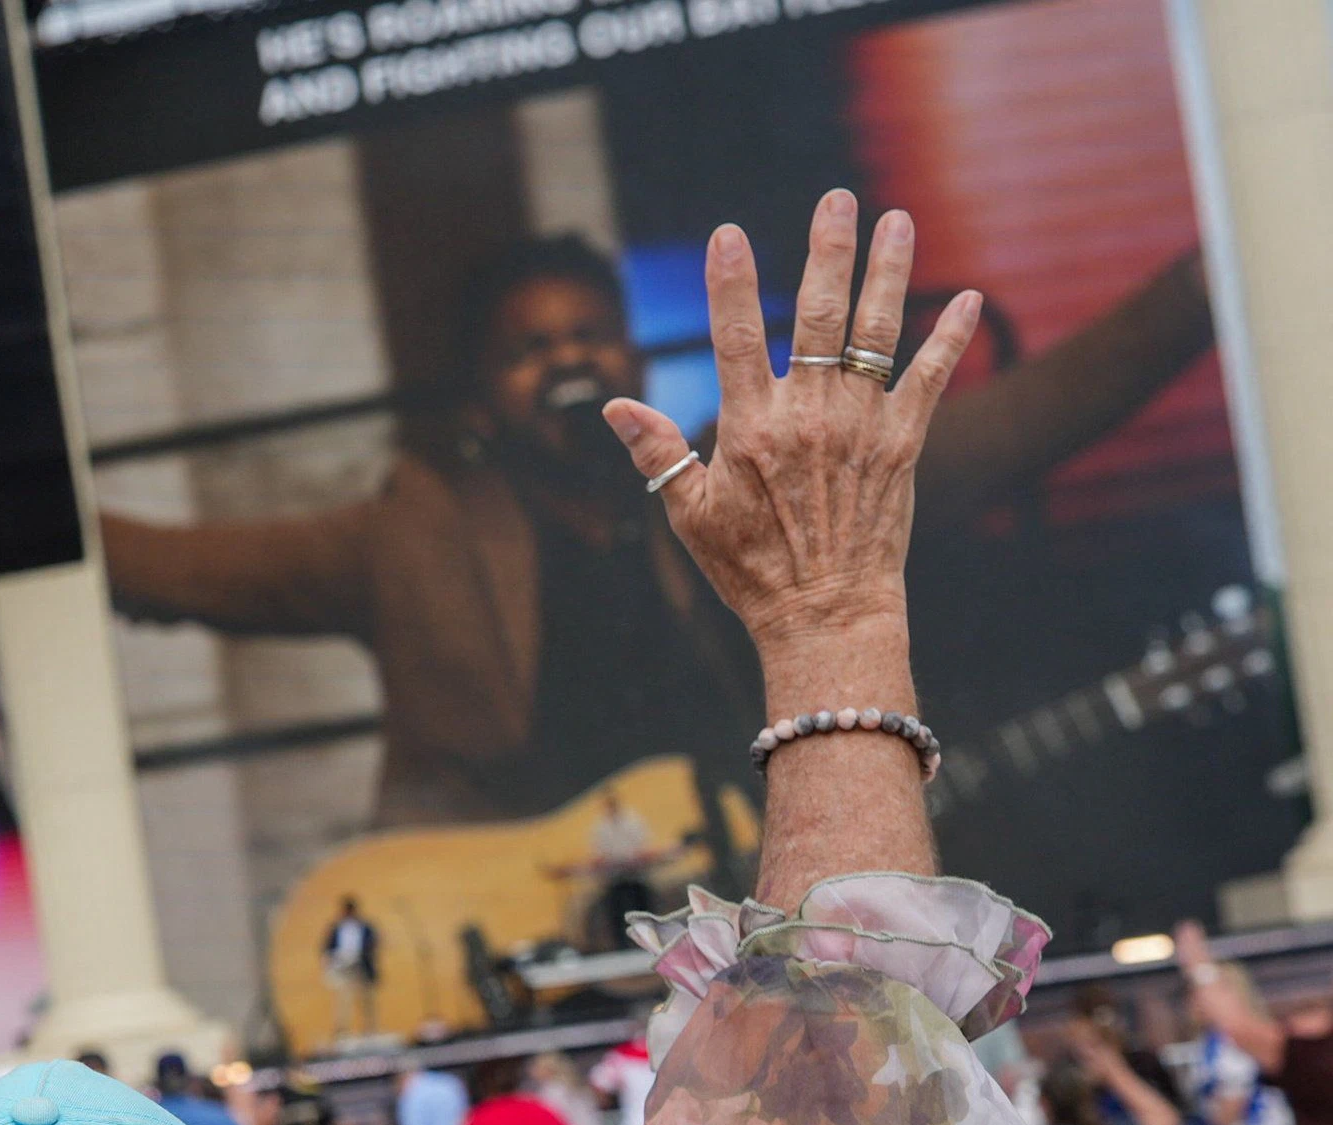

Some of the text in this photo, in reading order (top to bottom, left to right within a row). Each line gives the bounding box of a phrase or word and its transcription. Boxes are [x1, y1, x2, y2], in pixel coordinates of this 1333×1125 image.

[259, 64, 358, 126] AND
[361, 19, 574, 104] FIGHTING
[578, 0, 684, 59] OUR
